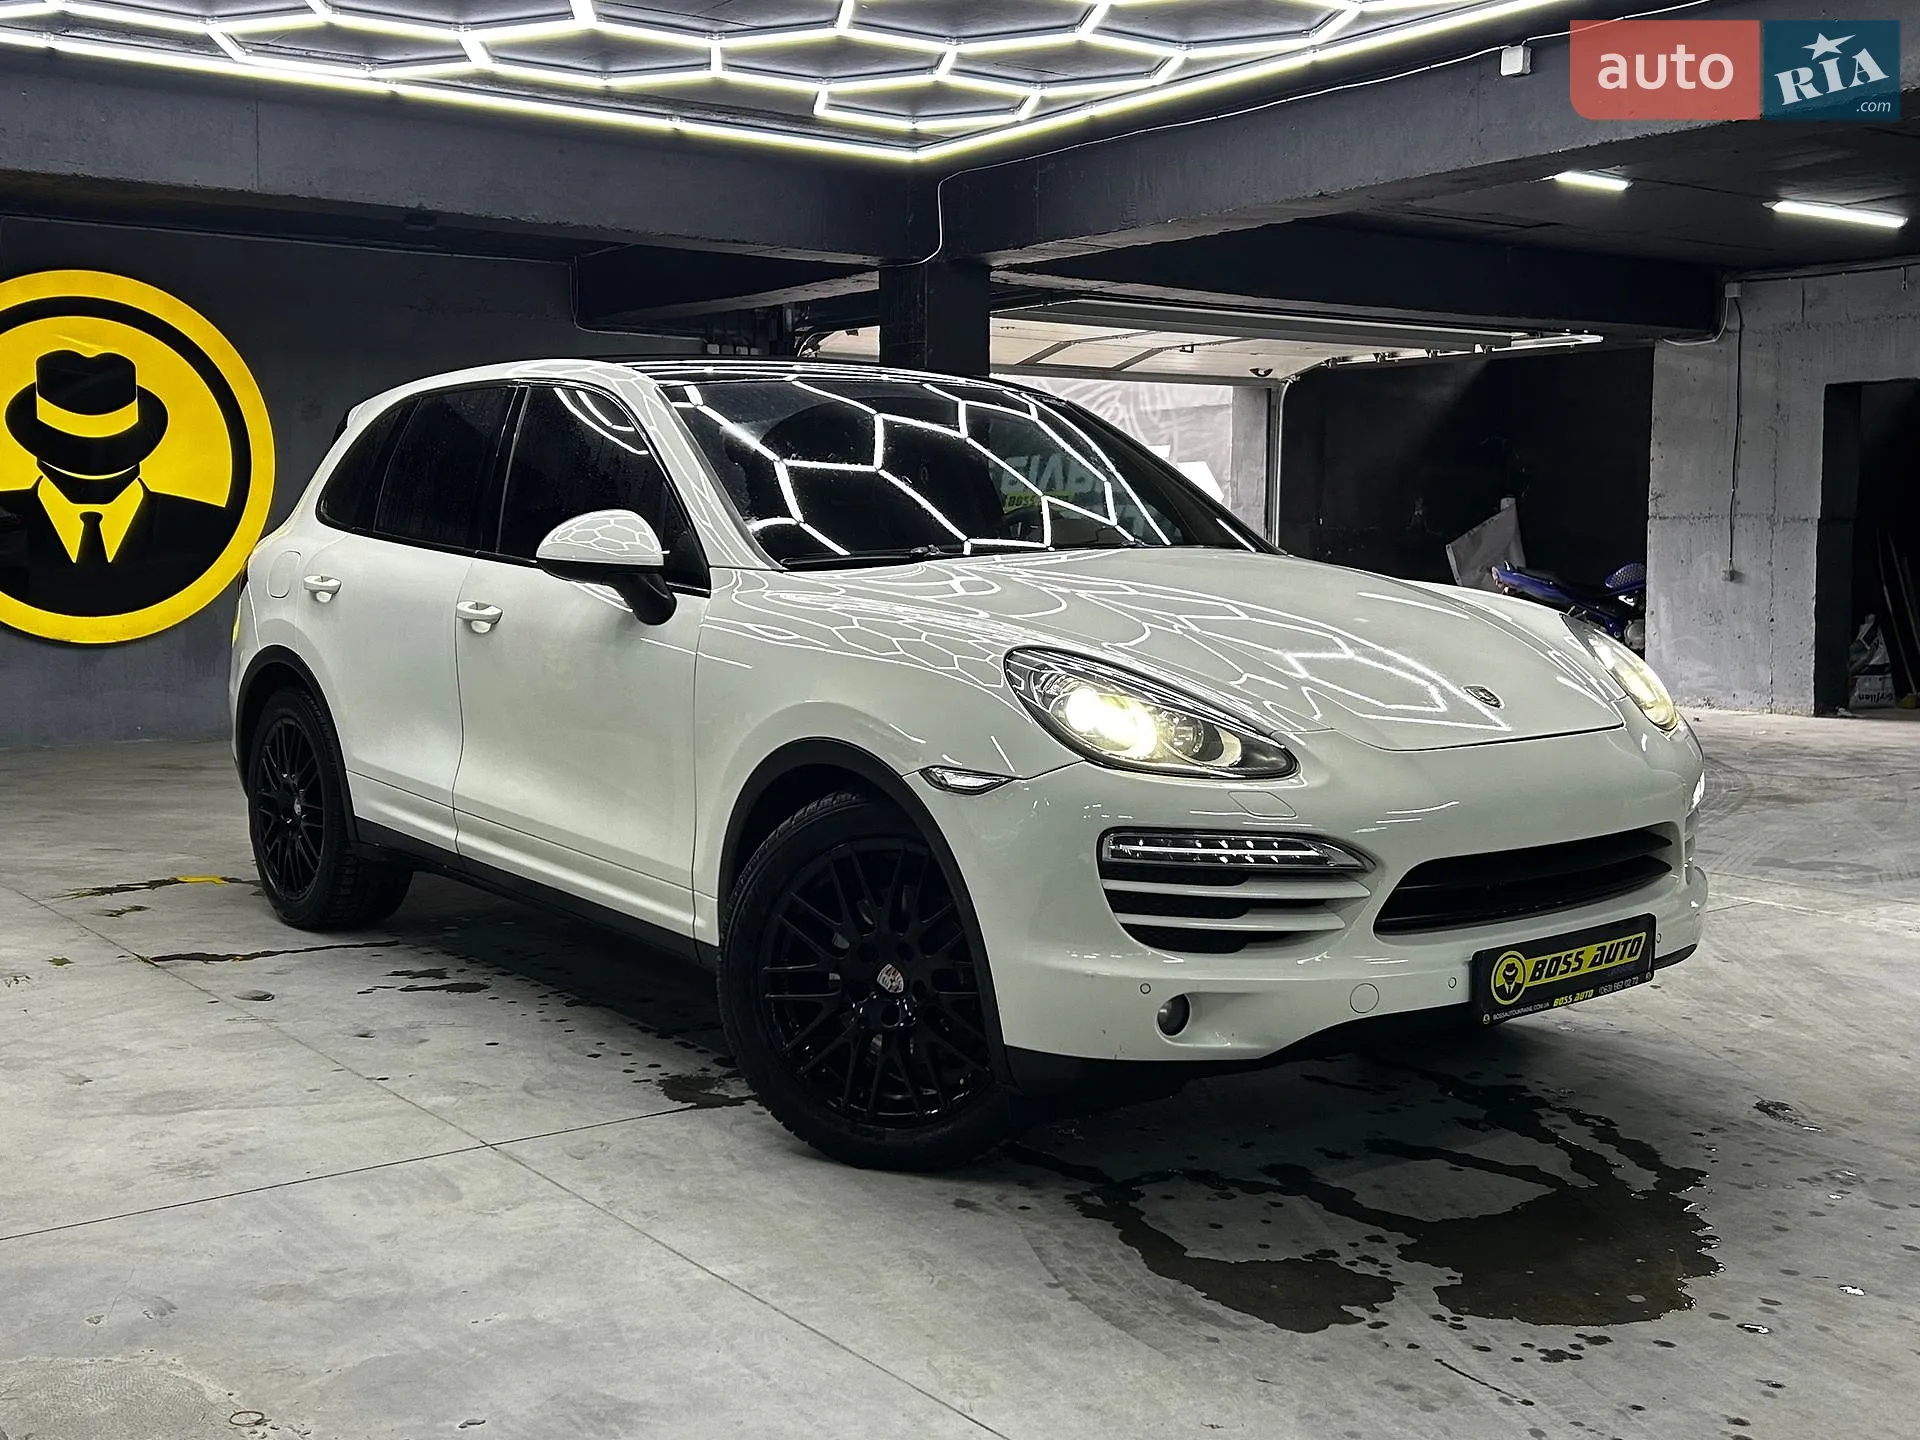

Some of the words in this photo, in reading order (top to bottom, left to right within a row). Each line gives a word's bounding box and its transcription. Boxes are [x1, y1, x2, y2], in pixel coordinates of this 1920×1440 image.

[1529, 950, 1585, 982] BOSS
[1587, 936, 1643, 968] AUTO
[1553, 994, 1573, 1007] BOSS
[1574, 989, 1594, 1002] AUTO
